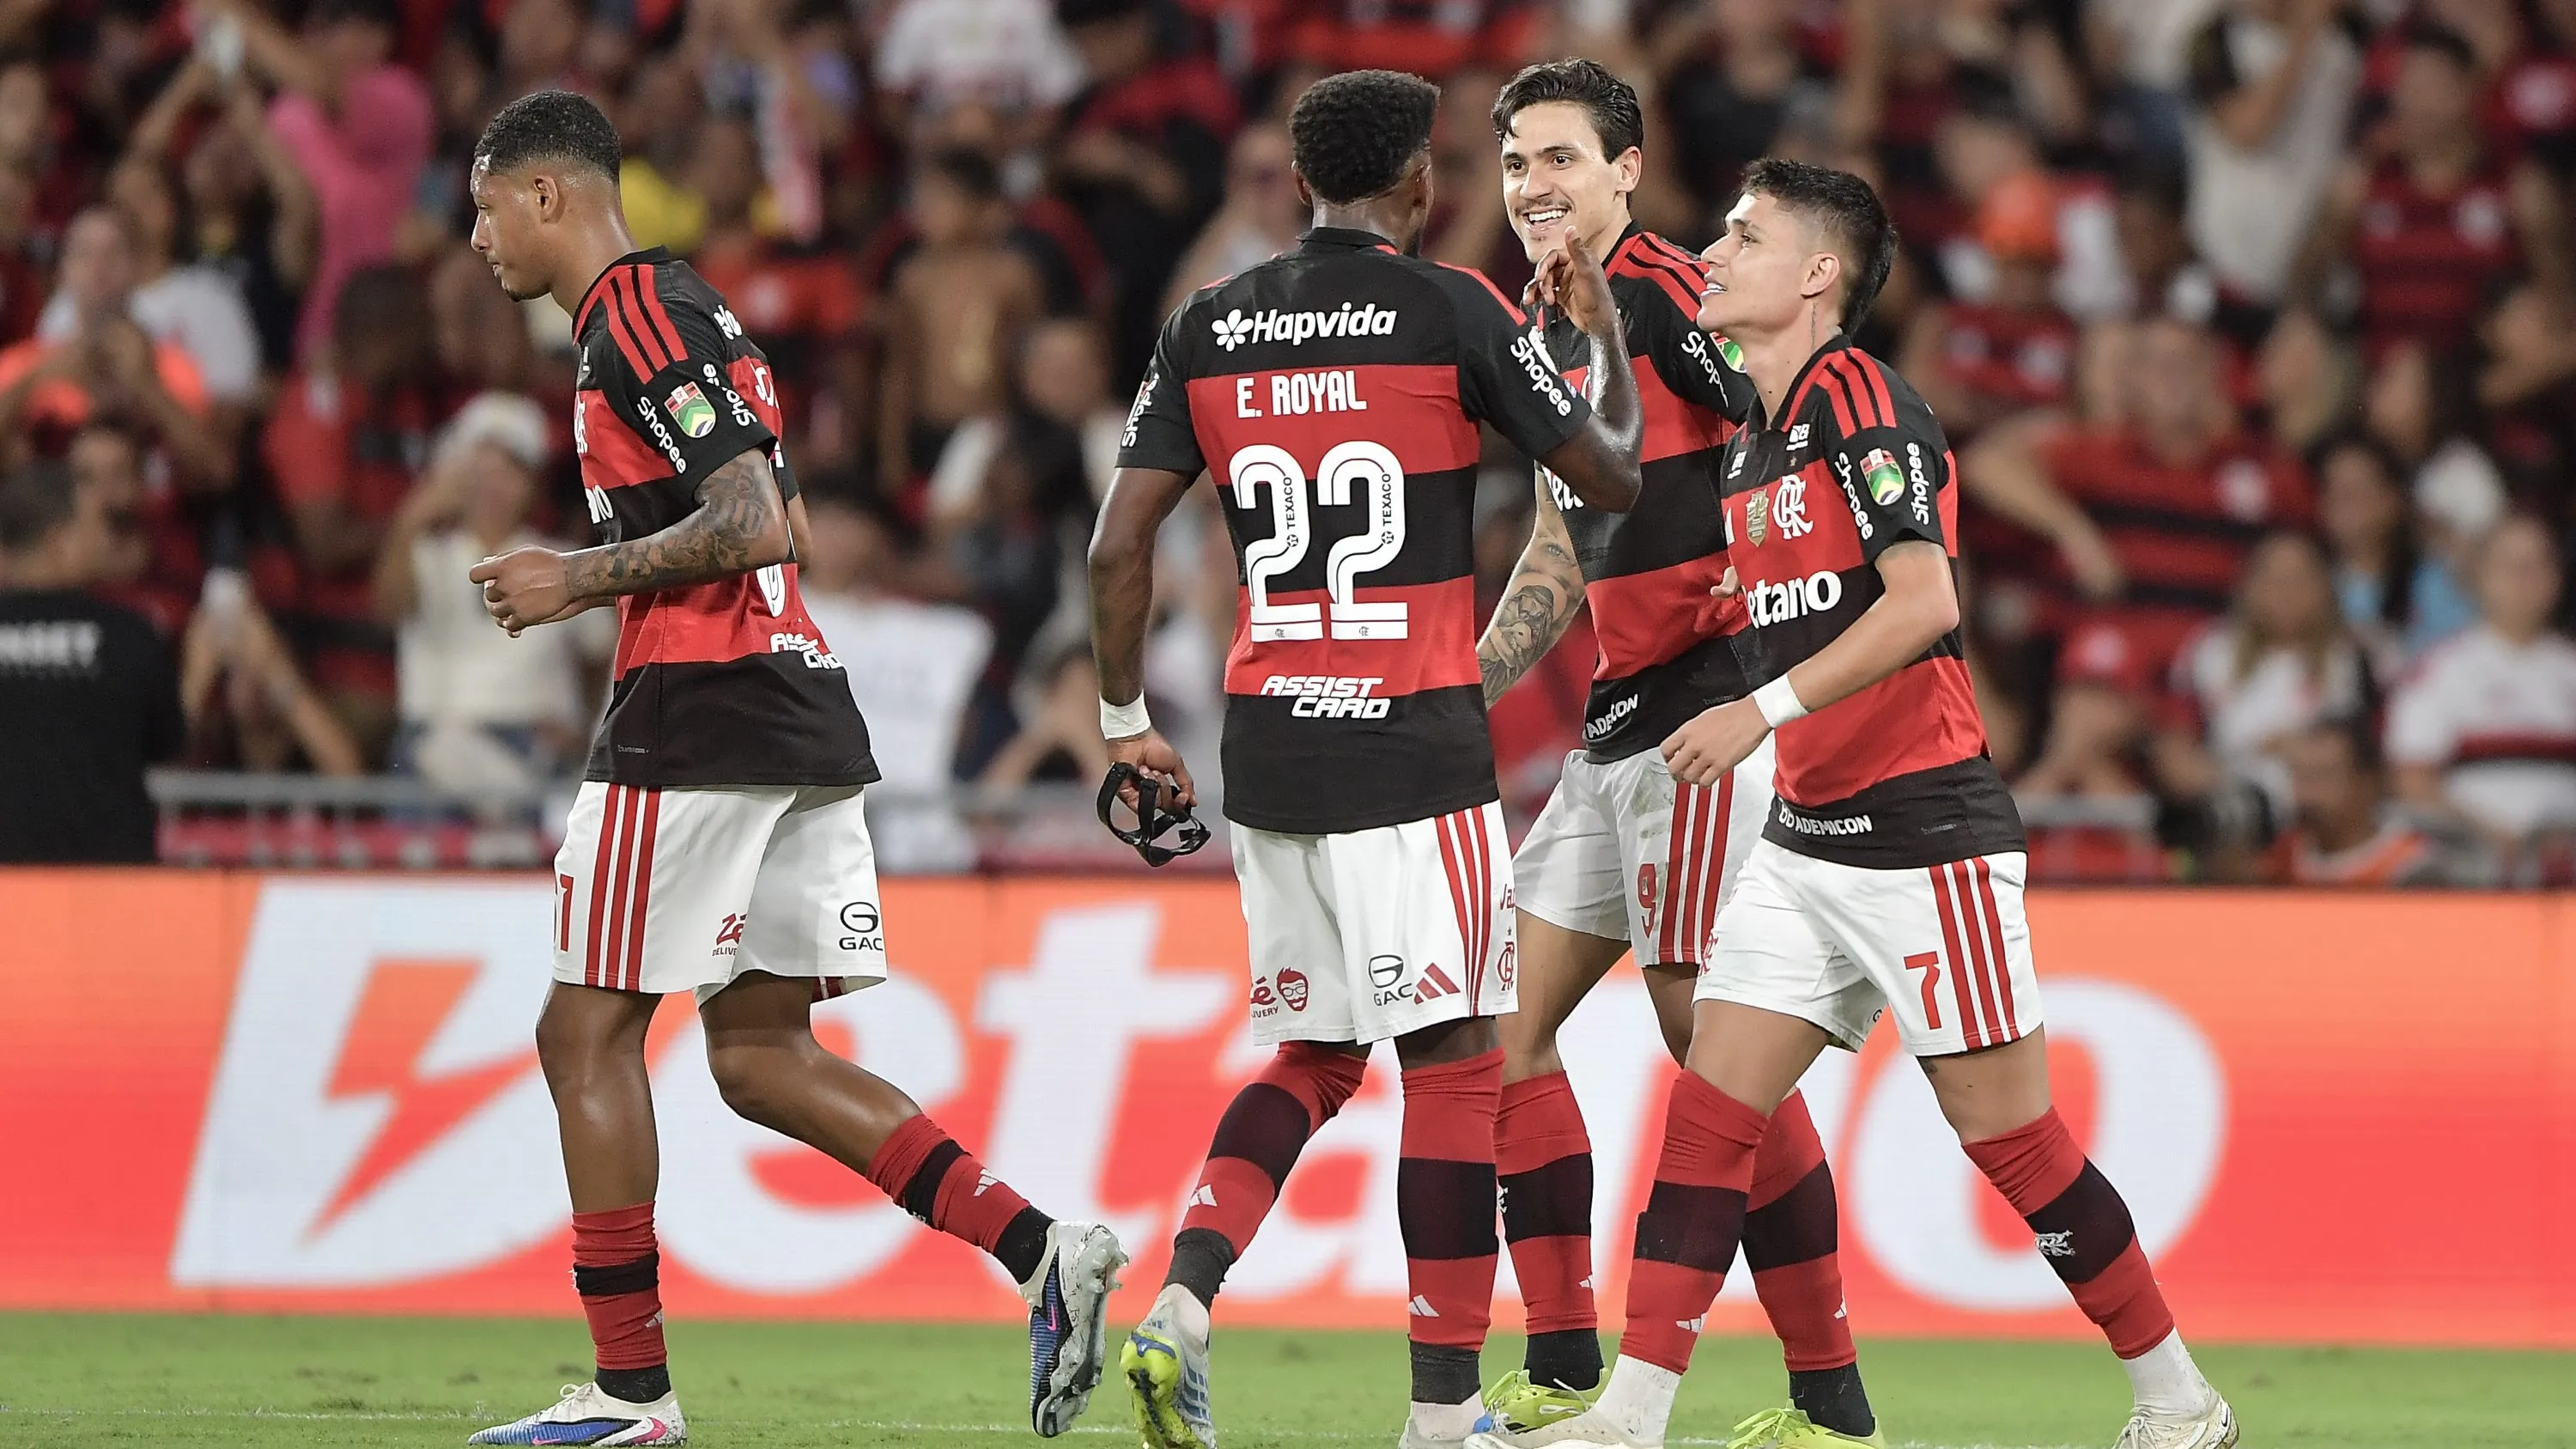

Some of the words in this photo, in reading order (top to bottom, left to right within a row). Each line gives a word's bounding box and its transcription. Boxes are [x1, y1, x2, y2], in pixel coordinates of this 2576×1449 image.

[1252, 301, 1398, 346] Hapvida
[703, 363, 757, 427] Shoe
[1236, 377, 1263, 418] E.
[1271, 370, 1368, 416] ROYAL
[1510, 336, 1571, 417] Shopee
[1681, 331, 1728, 408] Shop
[637, 396, 686, 473] Shopee
[1121, 372, 1159, 447] Shop
[1283, 477, 1296, 530] TEXACO
[1382, 473, 1392, 527] TEXACO
[1834, 452, 1874, 540] Shopee
[1906, 442, 1929, 525] Shopee
[1229, 440, 1408, 642] 22
[1741, 570, 1842, 630] etano
[1260, 675, 1383, 697] ASSIST
[1291, 697, 1391, 719] CARD
[1586, 694, 1638, 738] ADECON
[1795, 815, 1873, 837] ADEMICON
[1637, 863, 1656, 940] 9
[712, 947, 737, 956] DELIVE
[839, 937, 883, 951] GAC
[1250, 976, 1277, 1005] é
[1374, 983, 1413, 1006] GAC
[1904, 951, 1942, 1030] 7
